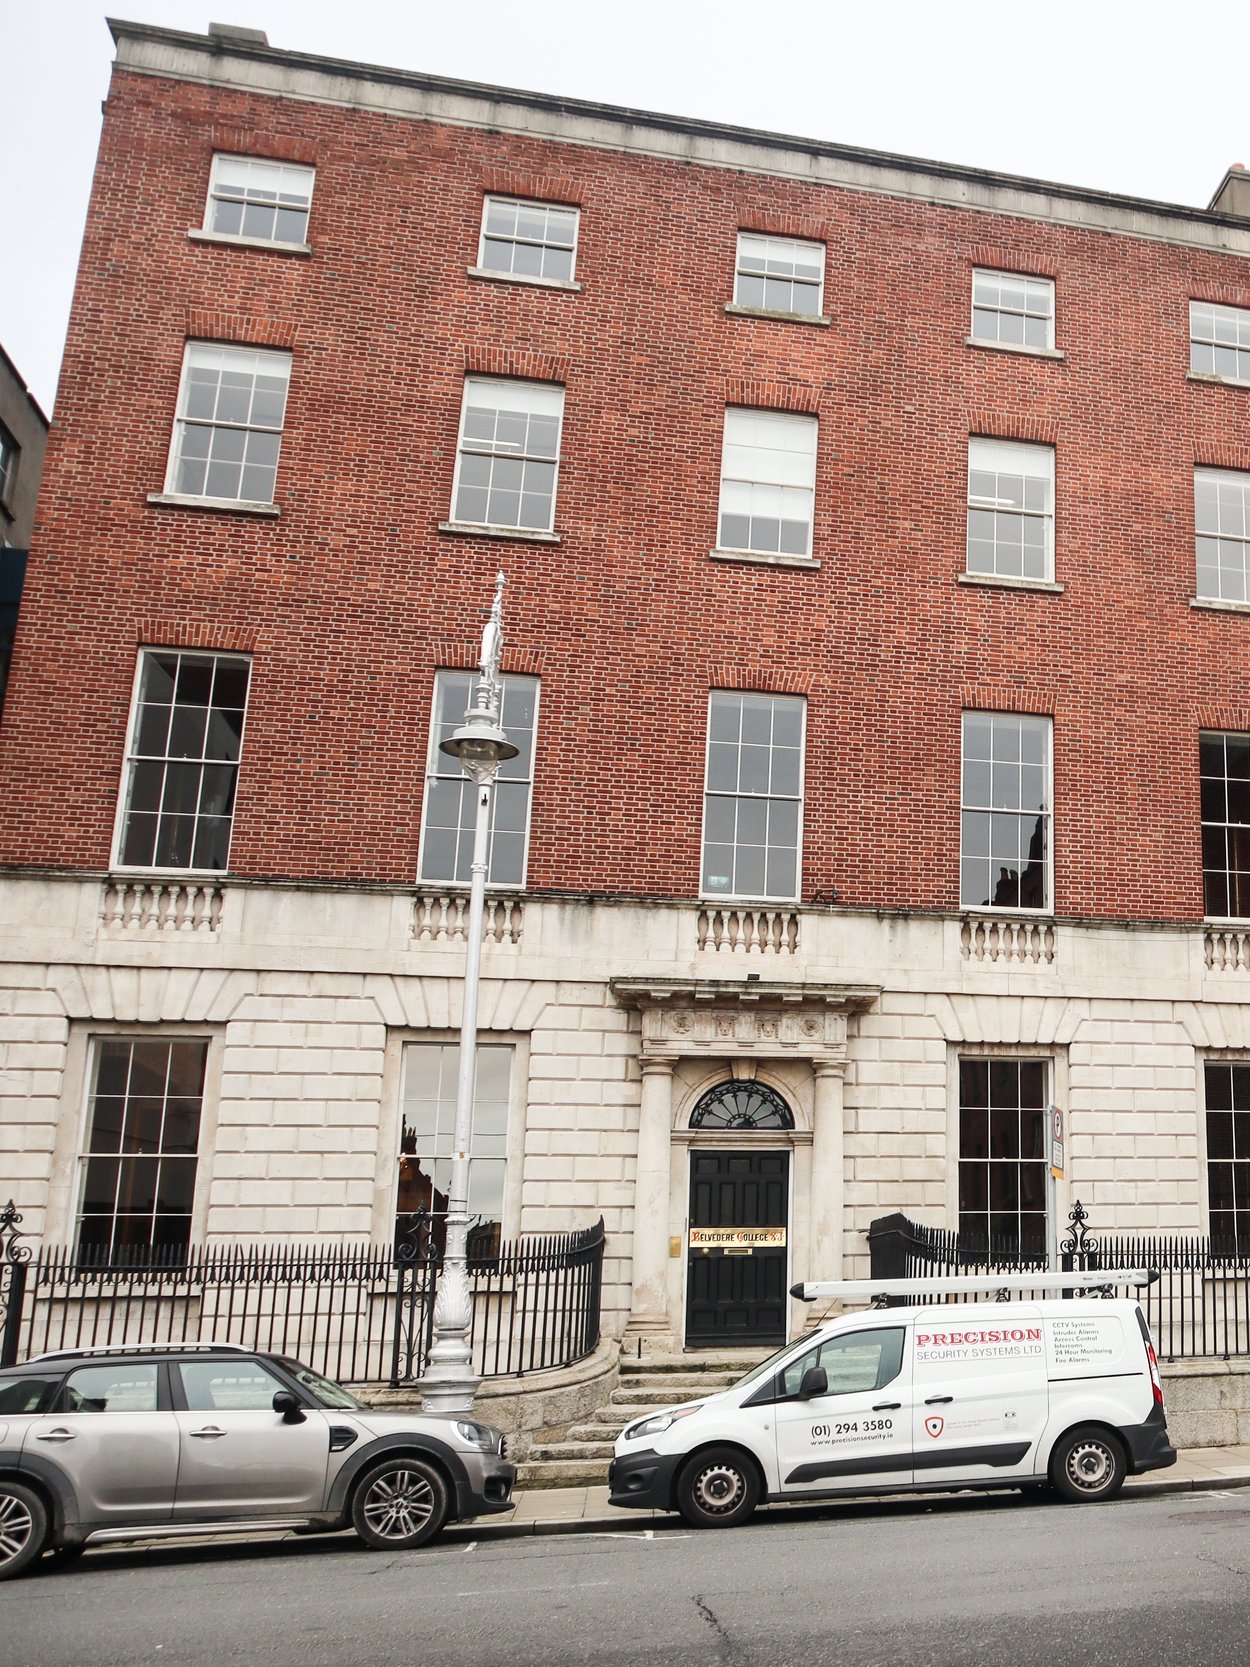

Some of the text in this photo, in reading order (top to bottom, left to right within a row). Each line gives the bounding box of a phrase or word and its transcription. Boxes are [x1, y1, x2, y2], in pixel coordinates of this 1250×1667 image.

[691, 1231, 735, 1242] BELVEDERE
[736, 1231, 769, 1243] COLLEGE
[915, 1328, 1043, 1347] PRECISION
[916, 1348, 969, 1360] SECURITY
[971, 1346, 1021, 1358] SYSTEMS
[1080, 1347, 1113, 1355] Monitoring
[811, 1419, 893, 1439] (01) 294 3580
[810, 1432, 894, 1446] www.precisionsecurity.ie
